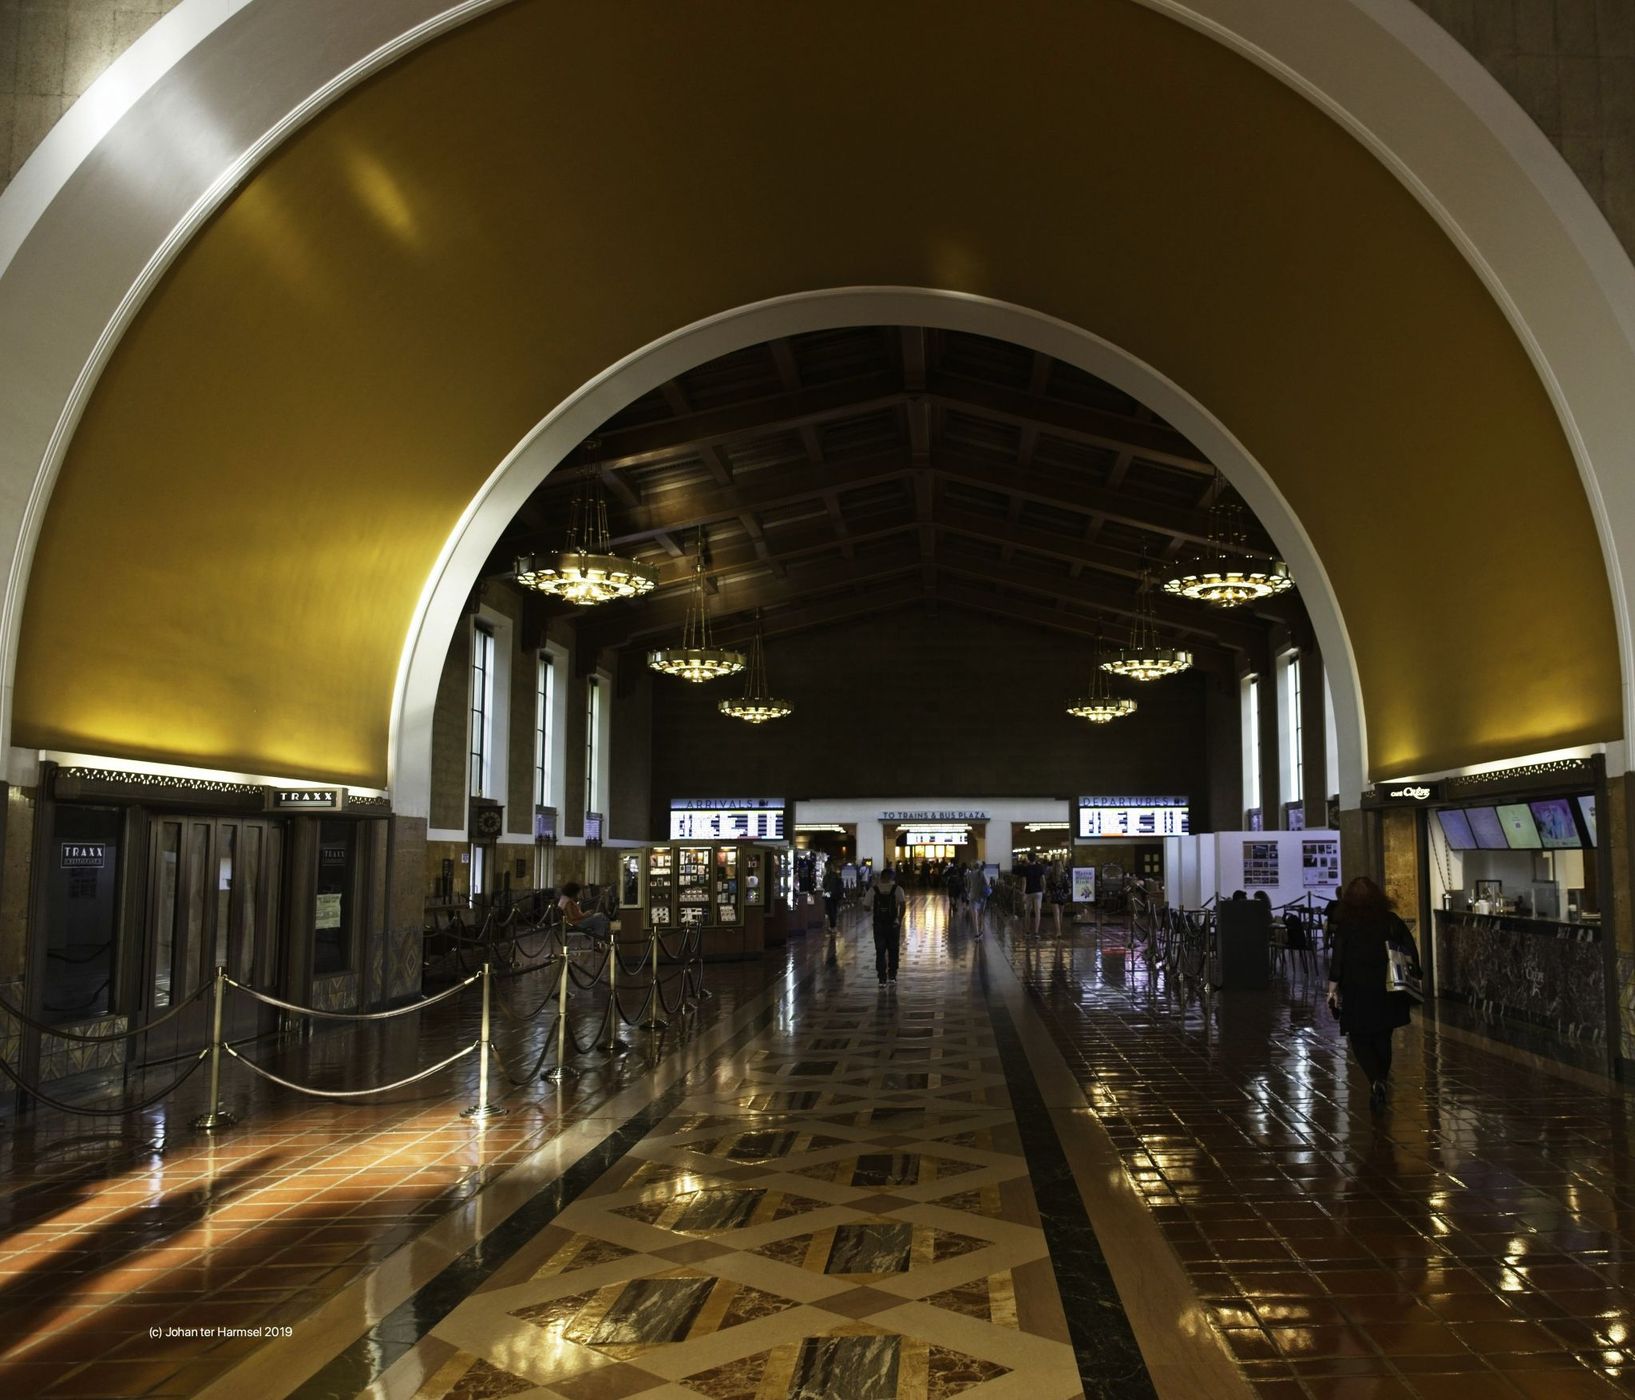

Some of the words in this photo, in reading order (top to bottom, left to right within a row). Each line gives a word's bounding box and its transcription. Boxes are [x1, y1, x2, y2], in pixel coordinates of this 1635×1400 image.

[280, 792, 332, 801] TRAXX
[686, 799, 753, 809] ARRIVALS
[1082, 797, 1169, 807] DEPARTURES
[883, 811, 895, 820] TO
[897, 811, 929, 820] TRAINS
[930, 811, 937, 820] &
[939, 811, 956, 820] BUS
[958, 810, 986, 819] PLAZA
[64, 847, 103, 857] TRAXX
